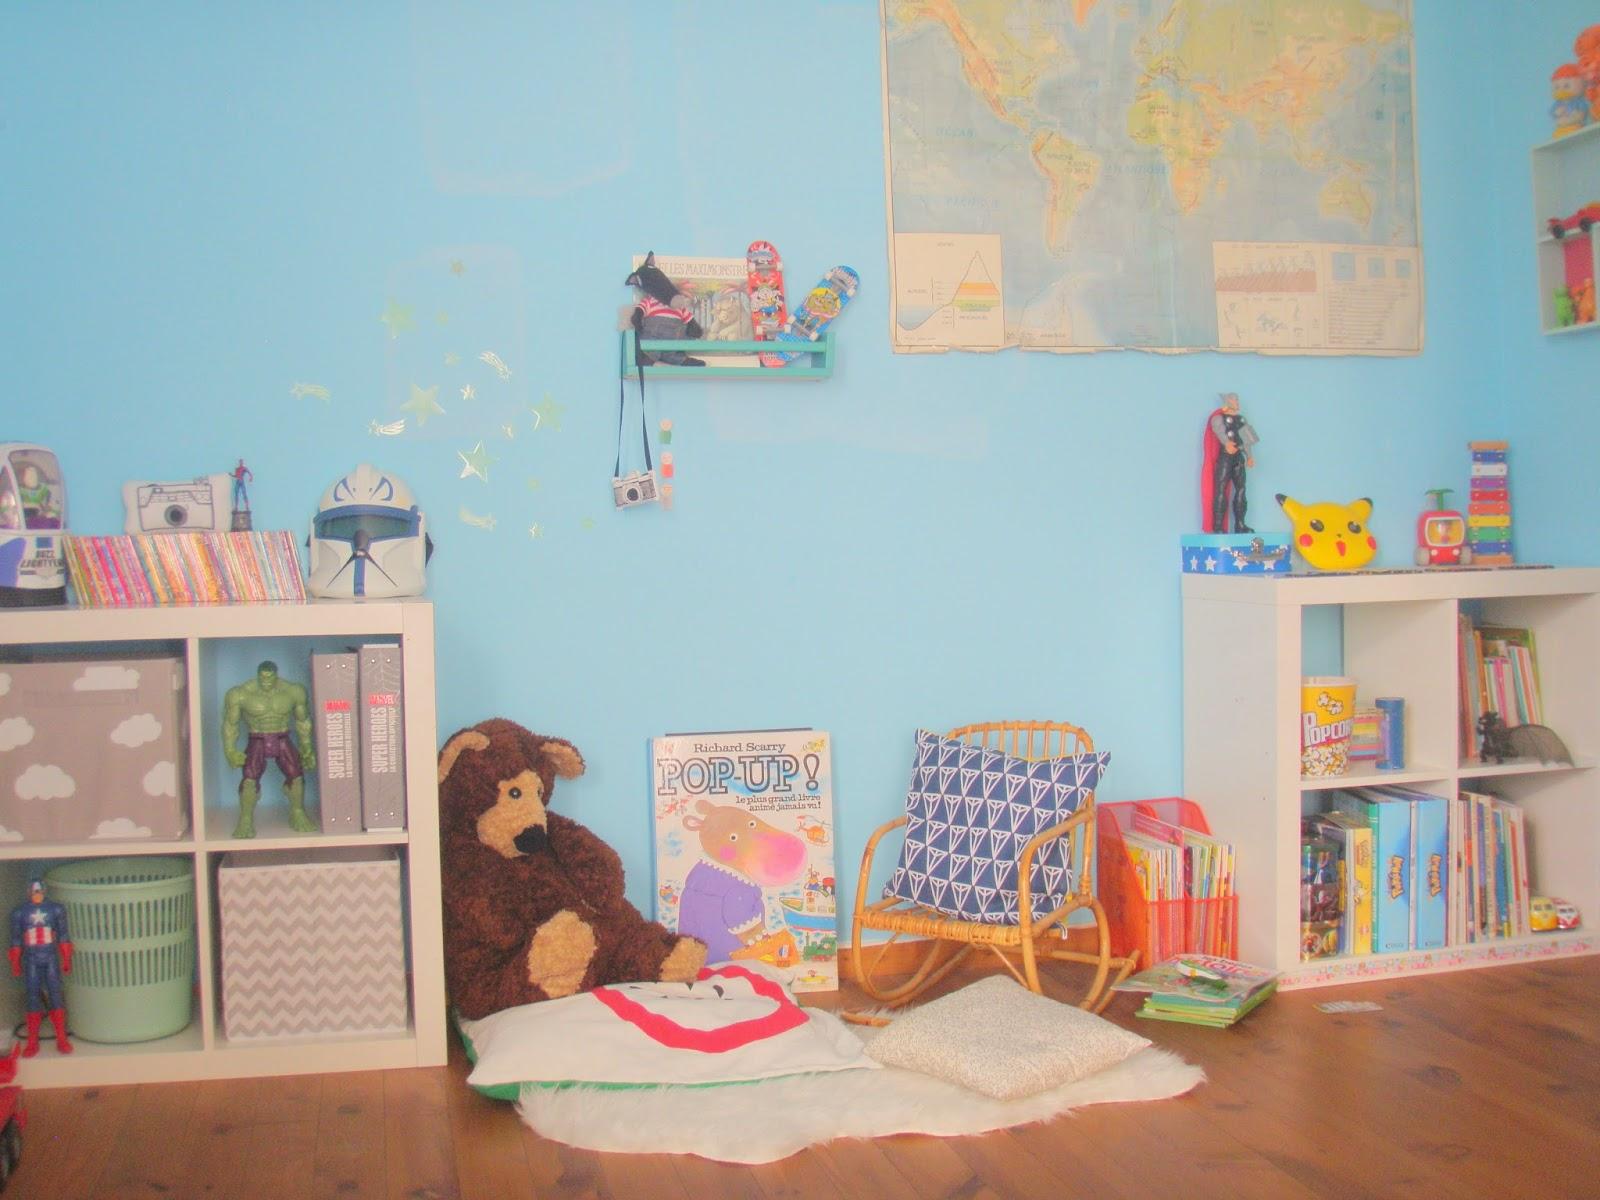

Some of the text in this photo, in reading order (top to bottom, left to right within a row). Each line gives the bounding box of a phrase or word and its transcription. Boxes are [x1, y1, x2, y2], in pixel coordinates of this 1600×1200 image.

[685, 263, 748, 277] MAXIMONSTRE
[326, 712, 344, 748] HEROES
[370, 707, 388, 773] SUPER HEROES
[694, 742, 786, 754] Richard Scarry
[328, 749, 345, 779] SUPER
[736, 793, 821, 806] le plus grand livre
[776, 802, 806, 812] jamais
